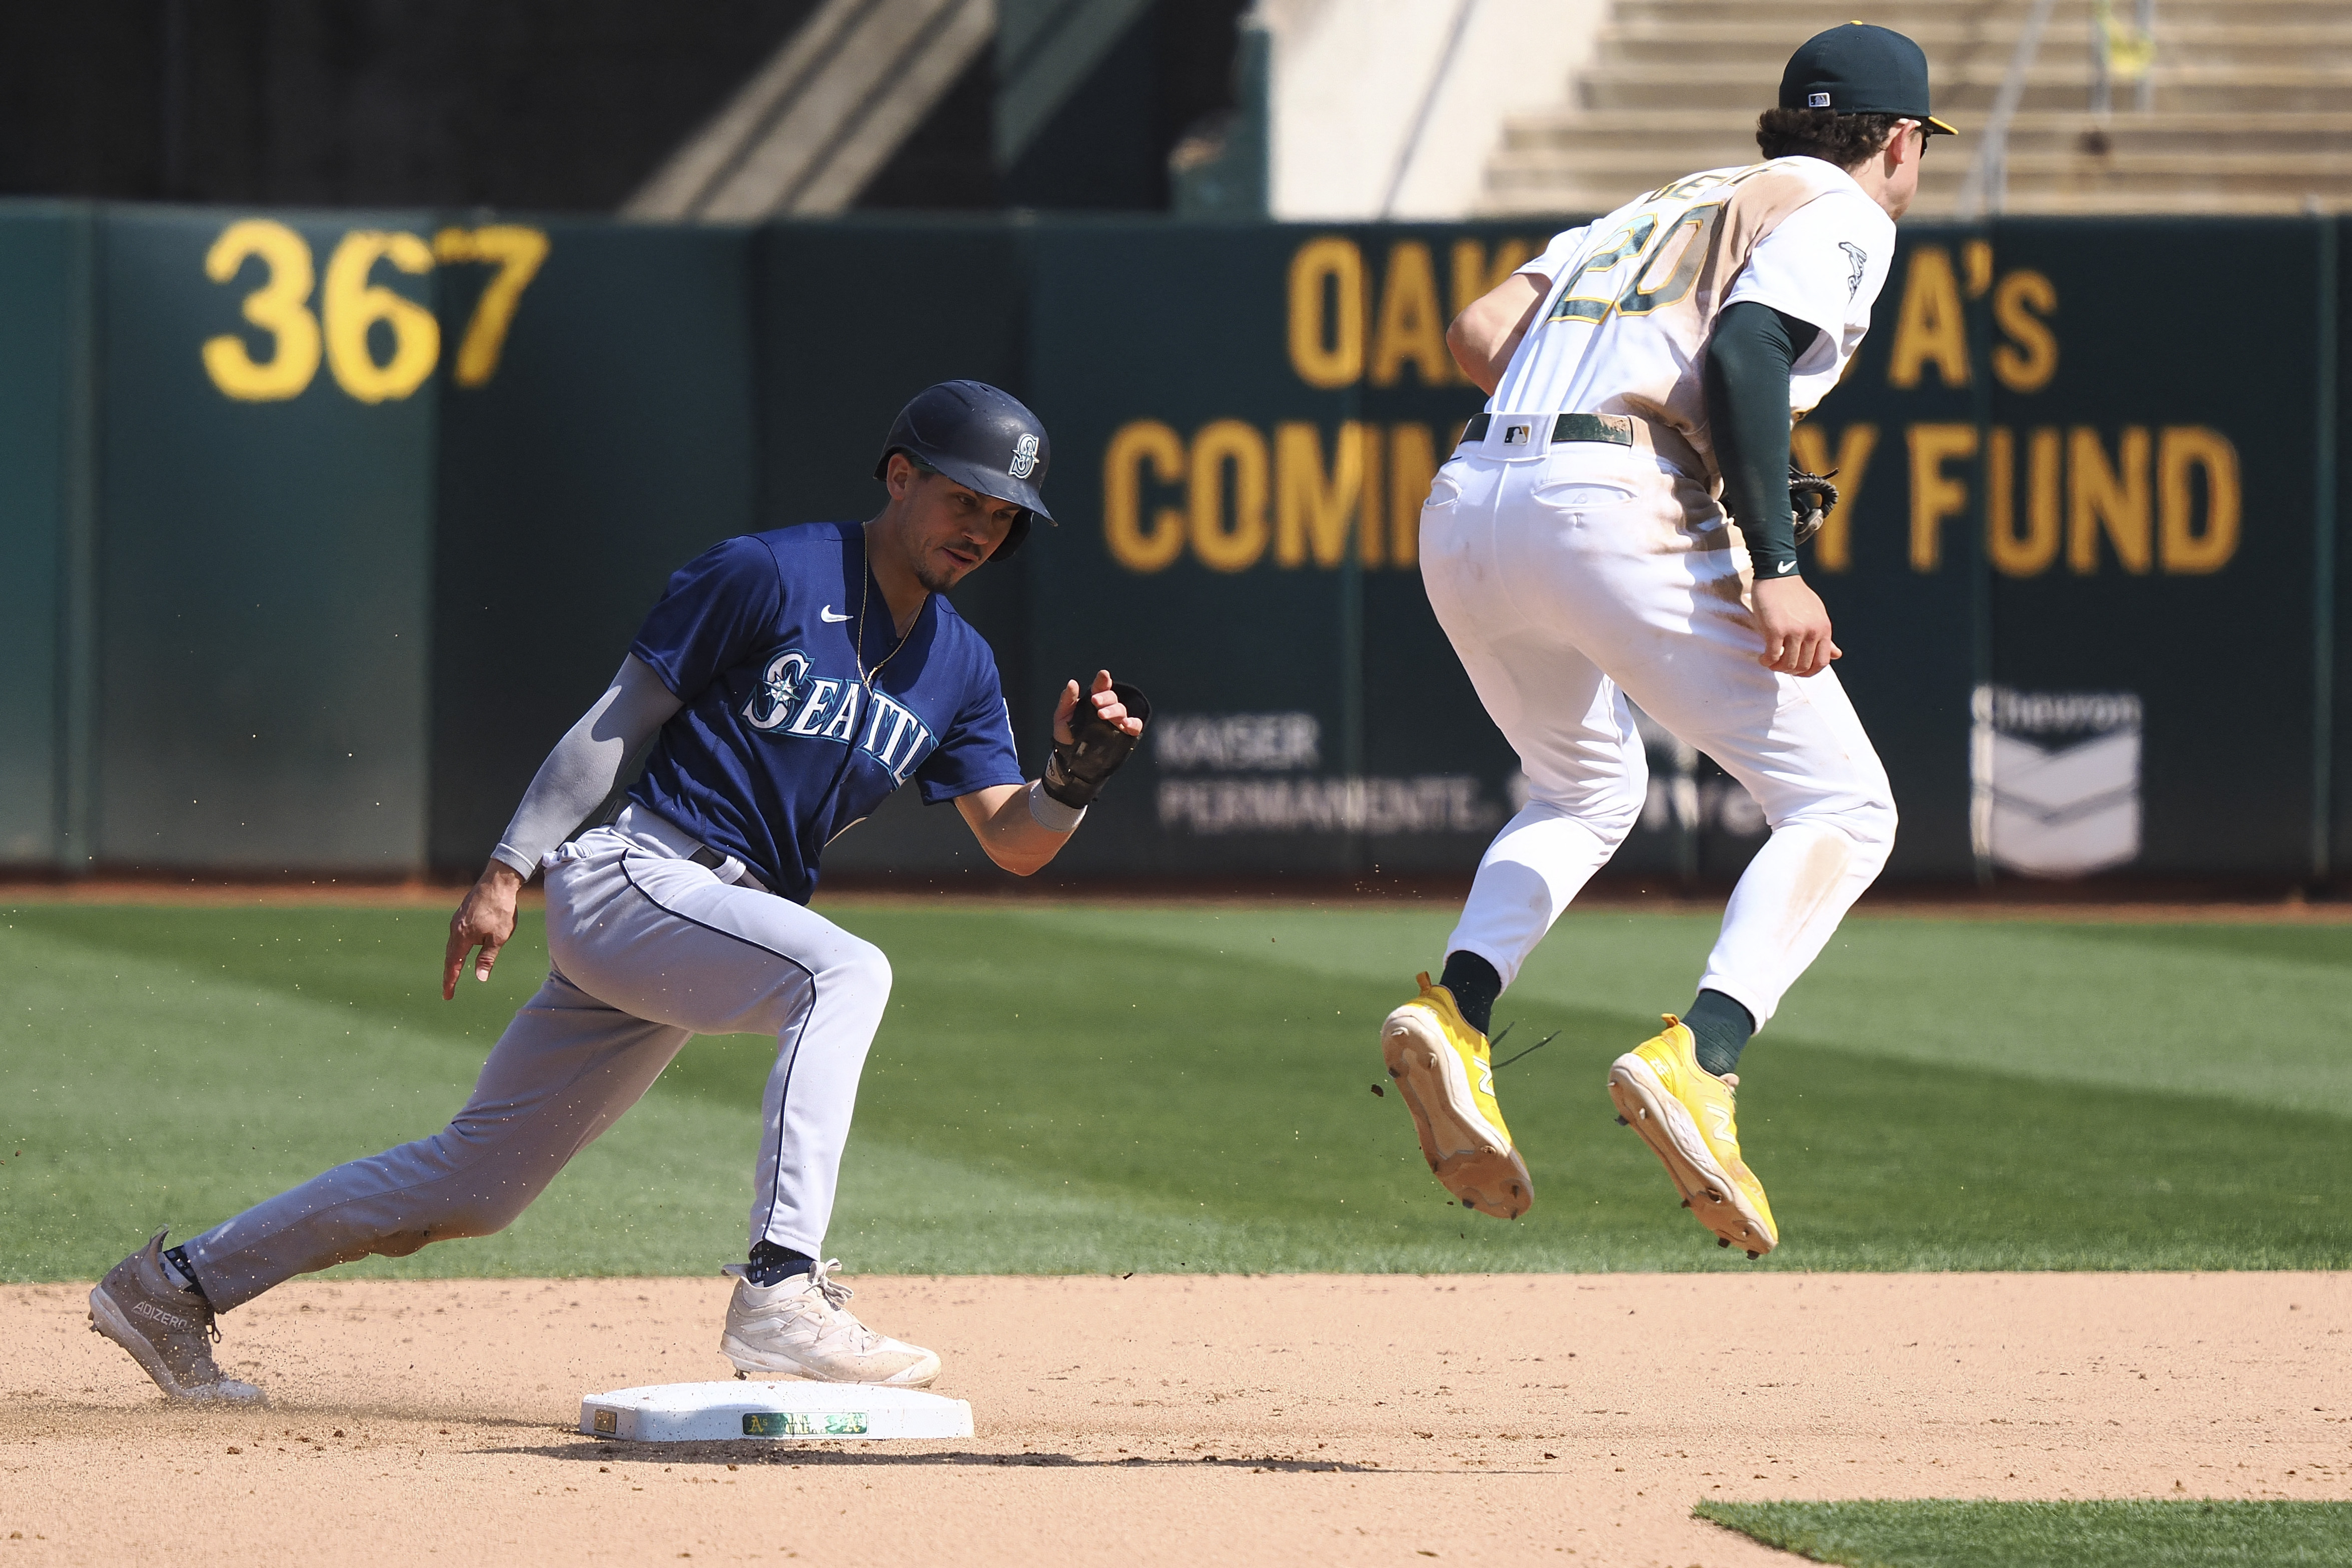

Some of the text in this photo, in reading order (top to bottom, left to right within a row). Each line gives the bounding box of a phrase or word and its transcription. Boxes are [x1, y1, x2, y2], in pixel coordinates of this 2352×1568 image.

[202, 219, 548, 402] 367
[1540, 201, 1724, 330] 20
[1889, 240, 2058, 393] A's
[1907, 422, 2241, 577] FUND
[739, 649, 938, 790] SEATTL
[1156, 714, 1319, 770] KAISER
[132, 1301, 188, 1328] ADIZERO
